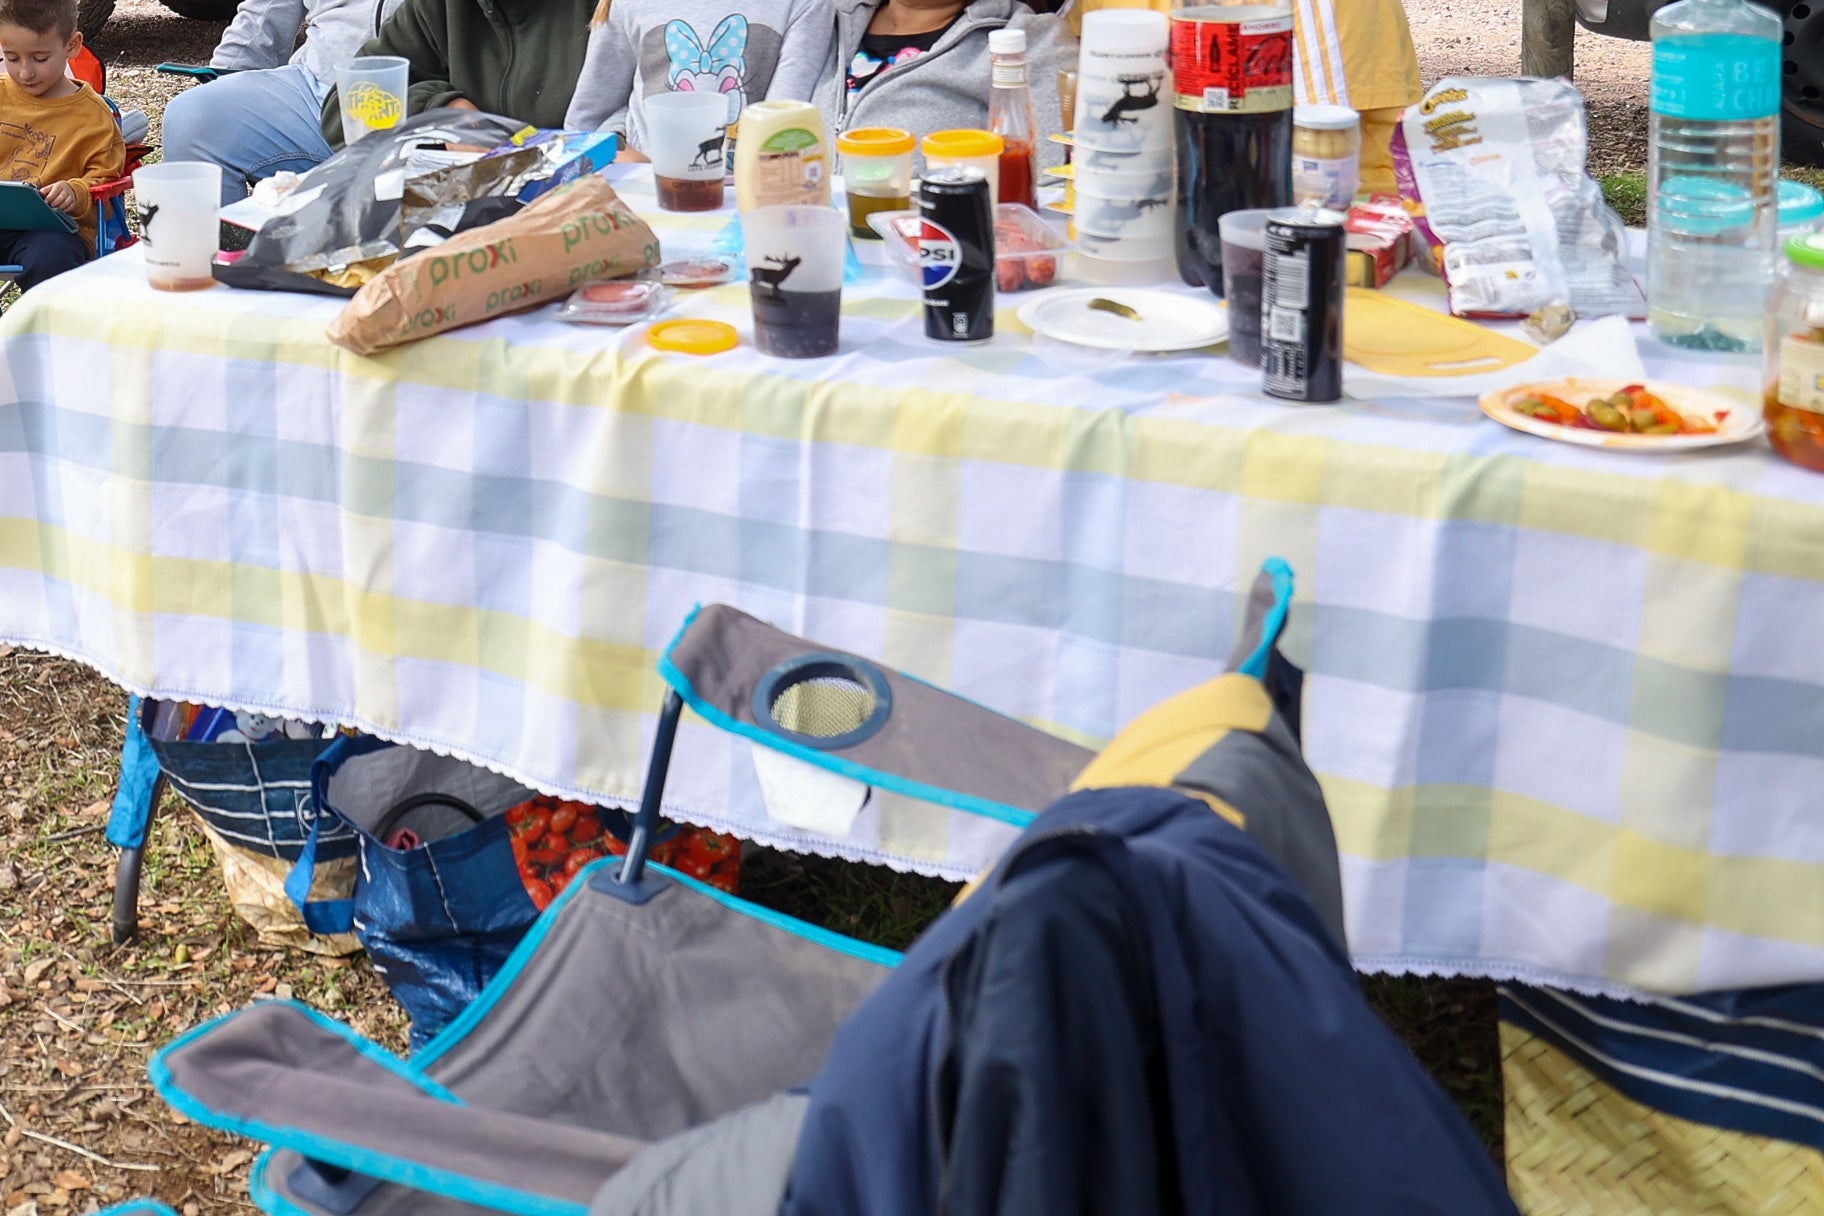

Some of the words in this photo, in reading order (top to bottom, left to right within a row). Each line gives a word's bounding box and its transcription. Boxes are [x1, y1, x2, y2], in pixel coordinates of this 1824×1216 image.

[429, 237, 517, 289] proxi
[920, 247, 955, 262] PSI
[485, 277, 543, 314] proxi
